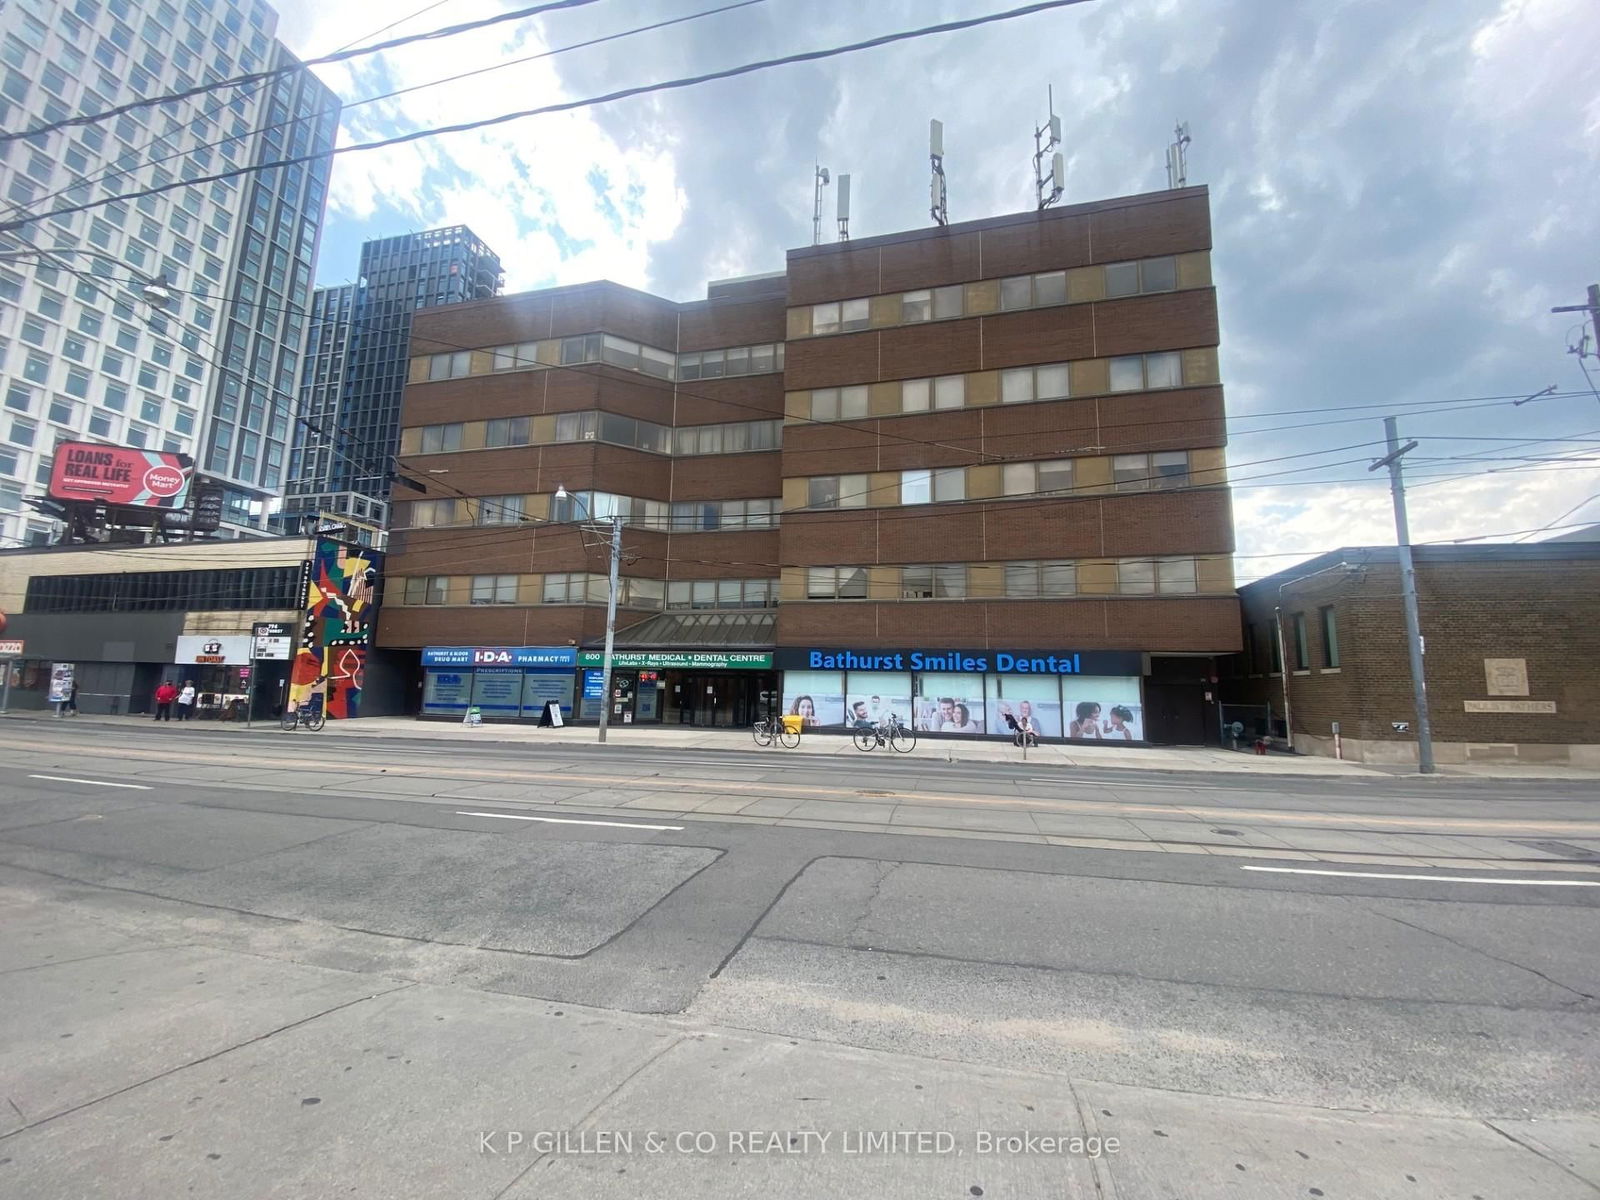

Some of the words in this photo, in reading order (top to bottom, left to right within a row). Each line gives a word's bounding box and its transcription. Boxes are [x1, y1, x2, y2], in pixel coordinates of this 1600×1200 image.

[68, 449, 113, 466] LOANS
[116, 459, 133, 468] for
[64, 463, 99, 479] REAL
[103, 467, 132, 482] LIFE
[149, 473, 180, 484] Money
[152, 481, 173, 489] Mart
[693, 654, 728, 662] DENTAL
[809, 651, 904, 670] Bathurst
[910, 652, 988, 671] Smiles
[996, 653, 1080, 673] Dental
